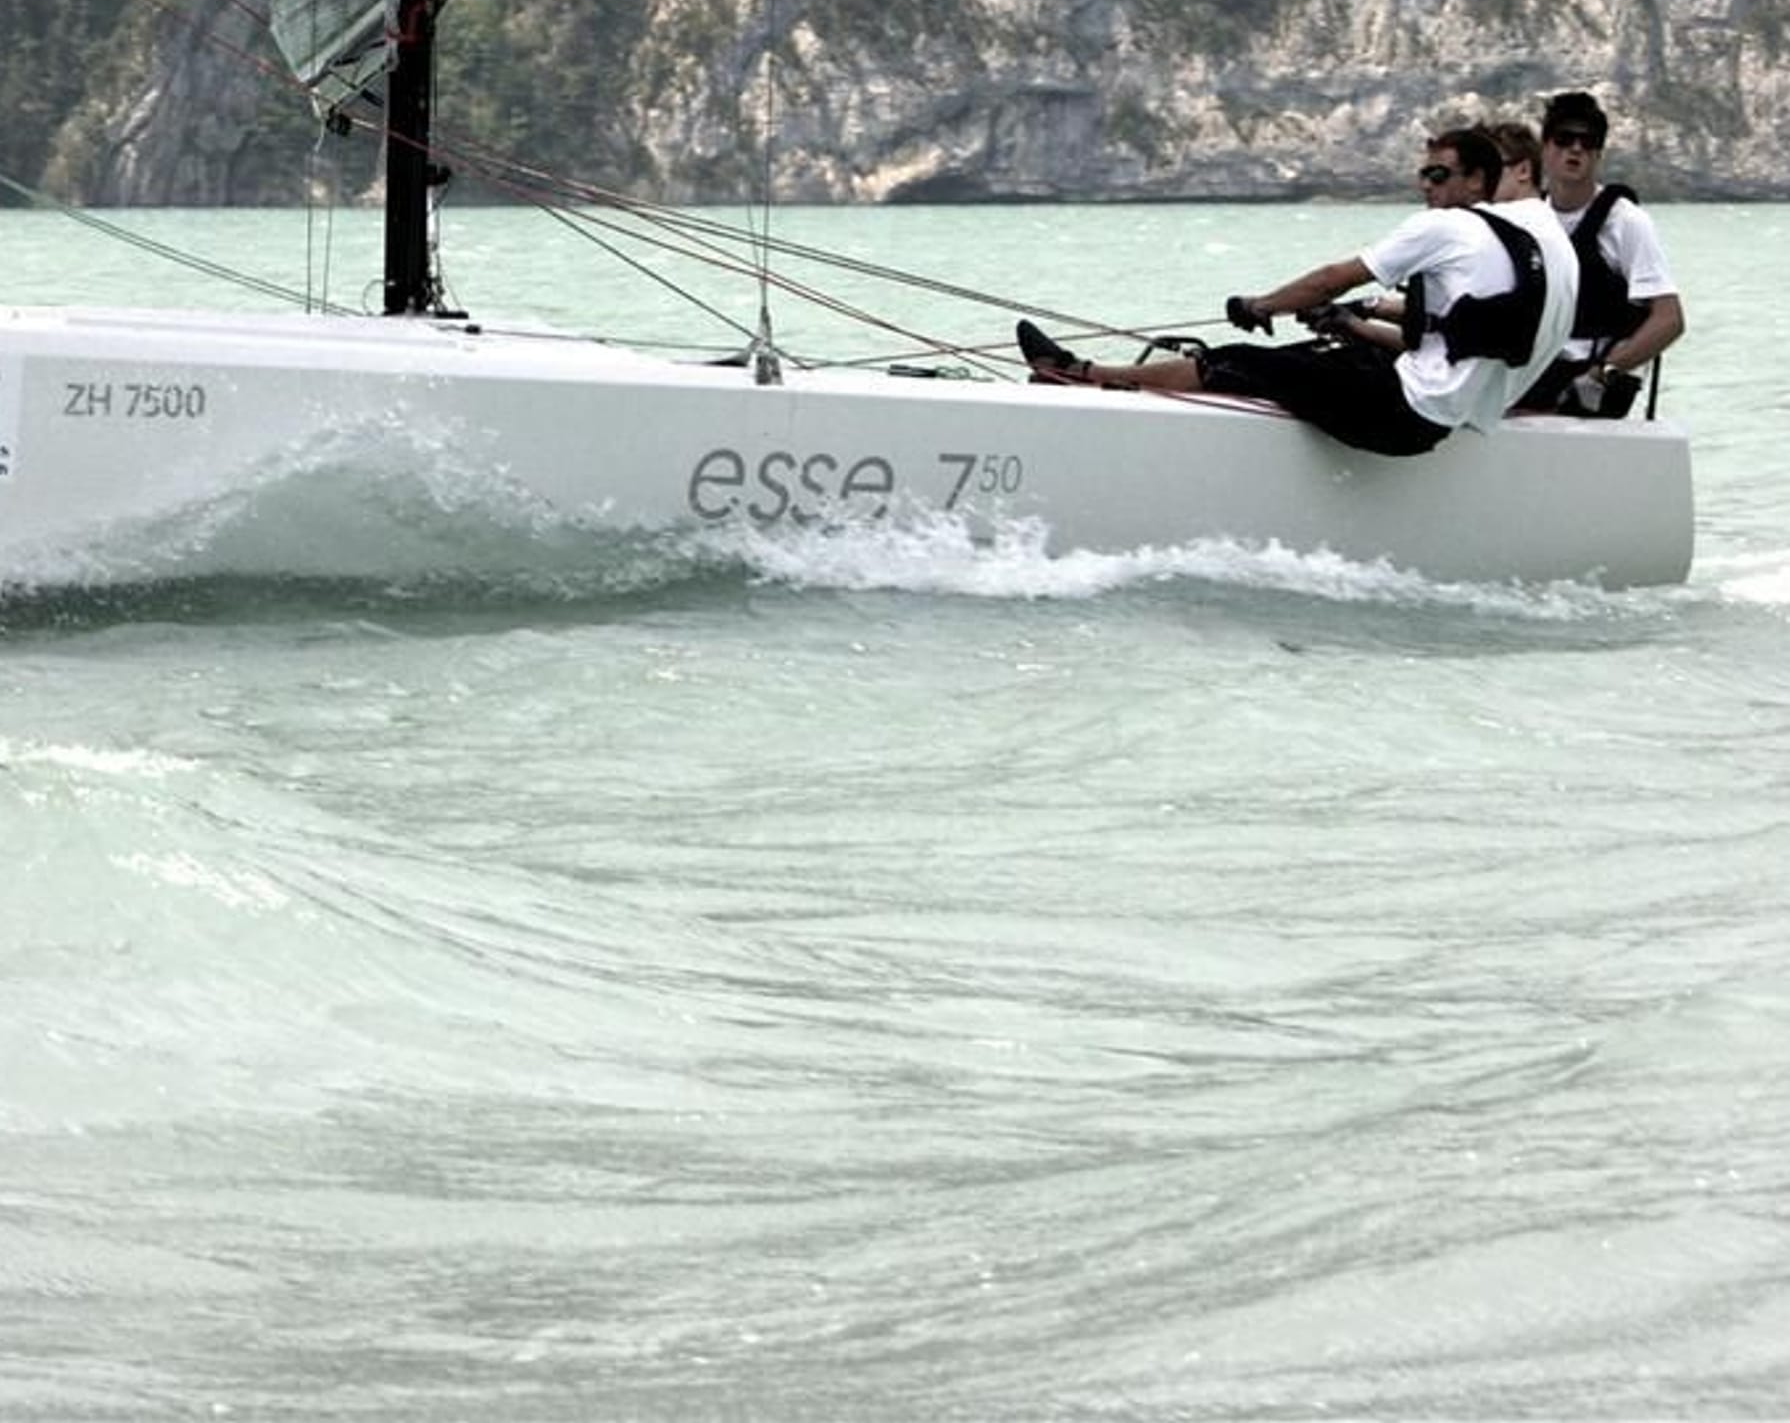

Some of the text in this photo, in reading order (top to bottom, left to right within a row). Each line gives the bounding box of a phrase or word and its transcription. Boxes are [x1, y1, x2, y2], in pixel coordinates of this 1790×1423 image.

[64, 383, 206, 418] ZH 7500
[687, 448, 895, 522] esse
